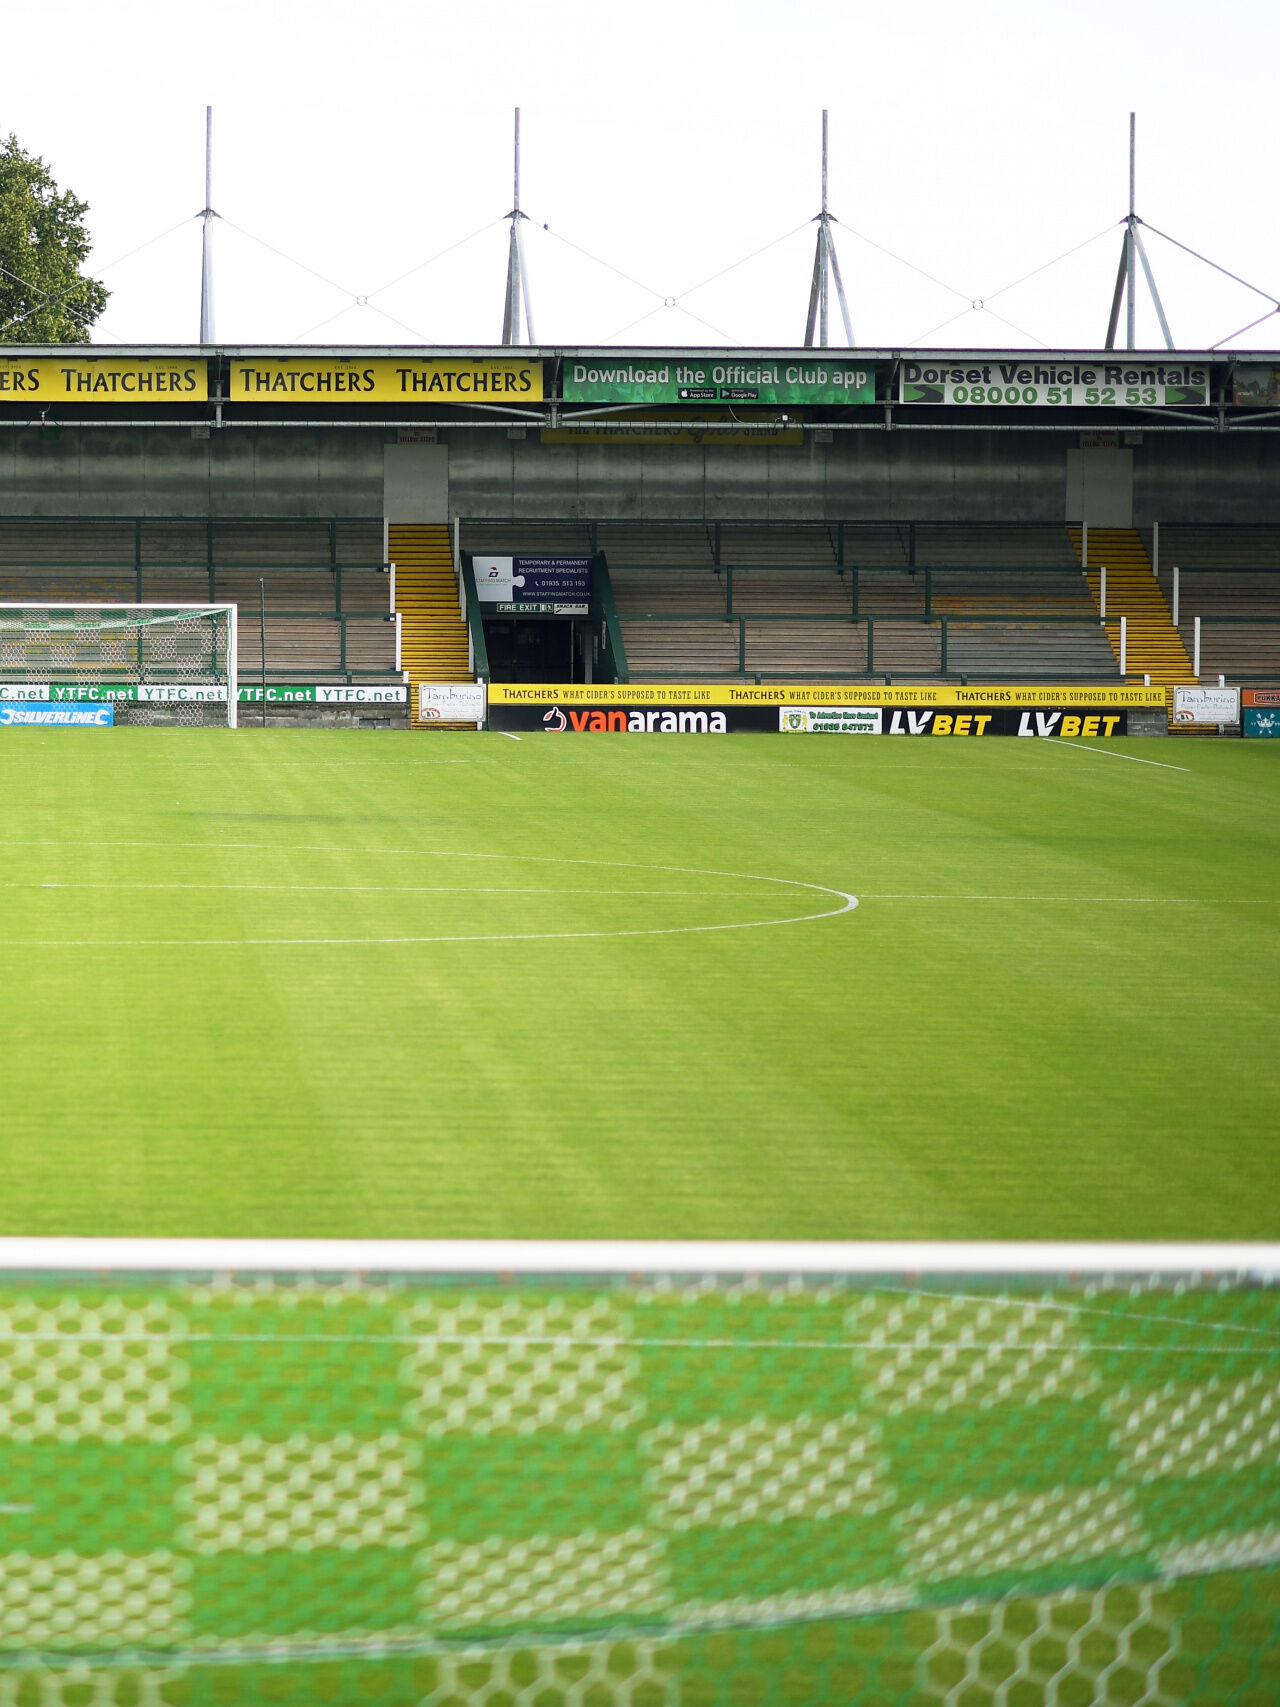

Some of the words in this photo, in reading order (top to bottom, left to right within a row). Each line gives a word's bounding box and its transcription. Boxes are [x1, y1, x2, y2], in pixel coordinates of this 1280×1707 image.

[61, 368, 196, 392] THATCHERS
[239, 368, 375, 392] THATCHERS
[396, 368, 531, 392] THATCHERS
[573, 365, 669, 383] Download
[676, 366, 705, 383] the
[712, 366, 780, 384] Official
[785, 366, 828, 384] Club
[832, 370, 867, 389] app
[904, 363, 992, 384] Dorset
[999, 364, 1096, 385] Vehicle
[1105, 366, 1206, 386] Rentals
[953, 386, 1038, 404] 08000
[1046, 387, 1072, 405] 51
[1084, 387, 1116, 405] 52
[1125, 387, 1157, 405] 53
[55, 687, 134, 700] YTFC.net
[144, 688, 223, 700] YTFC.net
[237, 689, 312, 701] YTFC.net
[323, 689, 400, 701] YTFC.net
[502, 688, 559, 699] THATCHERS
[563, 690, 584, 699] WHAT
[617, 690, 654, 700] SUPPOSED
[657, 690, 666, 700] TO
[668, 690, 691, 700] TASTE
[694, 690, 710, 700] LIKE
[729, 689, 785, 700] THATCHERS
[789, 691, 810, 700] WHAT
[844, 692, 881, 701] SUPPOSED
[883, 692, 893, 701] TO
[895, 692, 918, 701] TASTE
[920, 692, 937, 701] LIKE
[955, 691, 1011, 701] THATCHERS
[1015, 692, 1036, 701] WHAT
[1069, 692, 1106, 702] SUPPOSED
[1109, 692, 1118, 702] TO
[1120, 692, 1143, 702] TASTE
[1145, 692, 1162, 702] LIKE
[1177, 690, 1235, 703] Tamburino
[569, 711, 727, 734] vanarama
[889, 711, 992, 736] LVBET
[1017, 712, 1121, 737] LVBET
